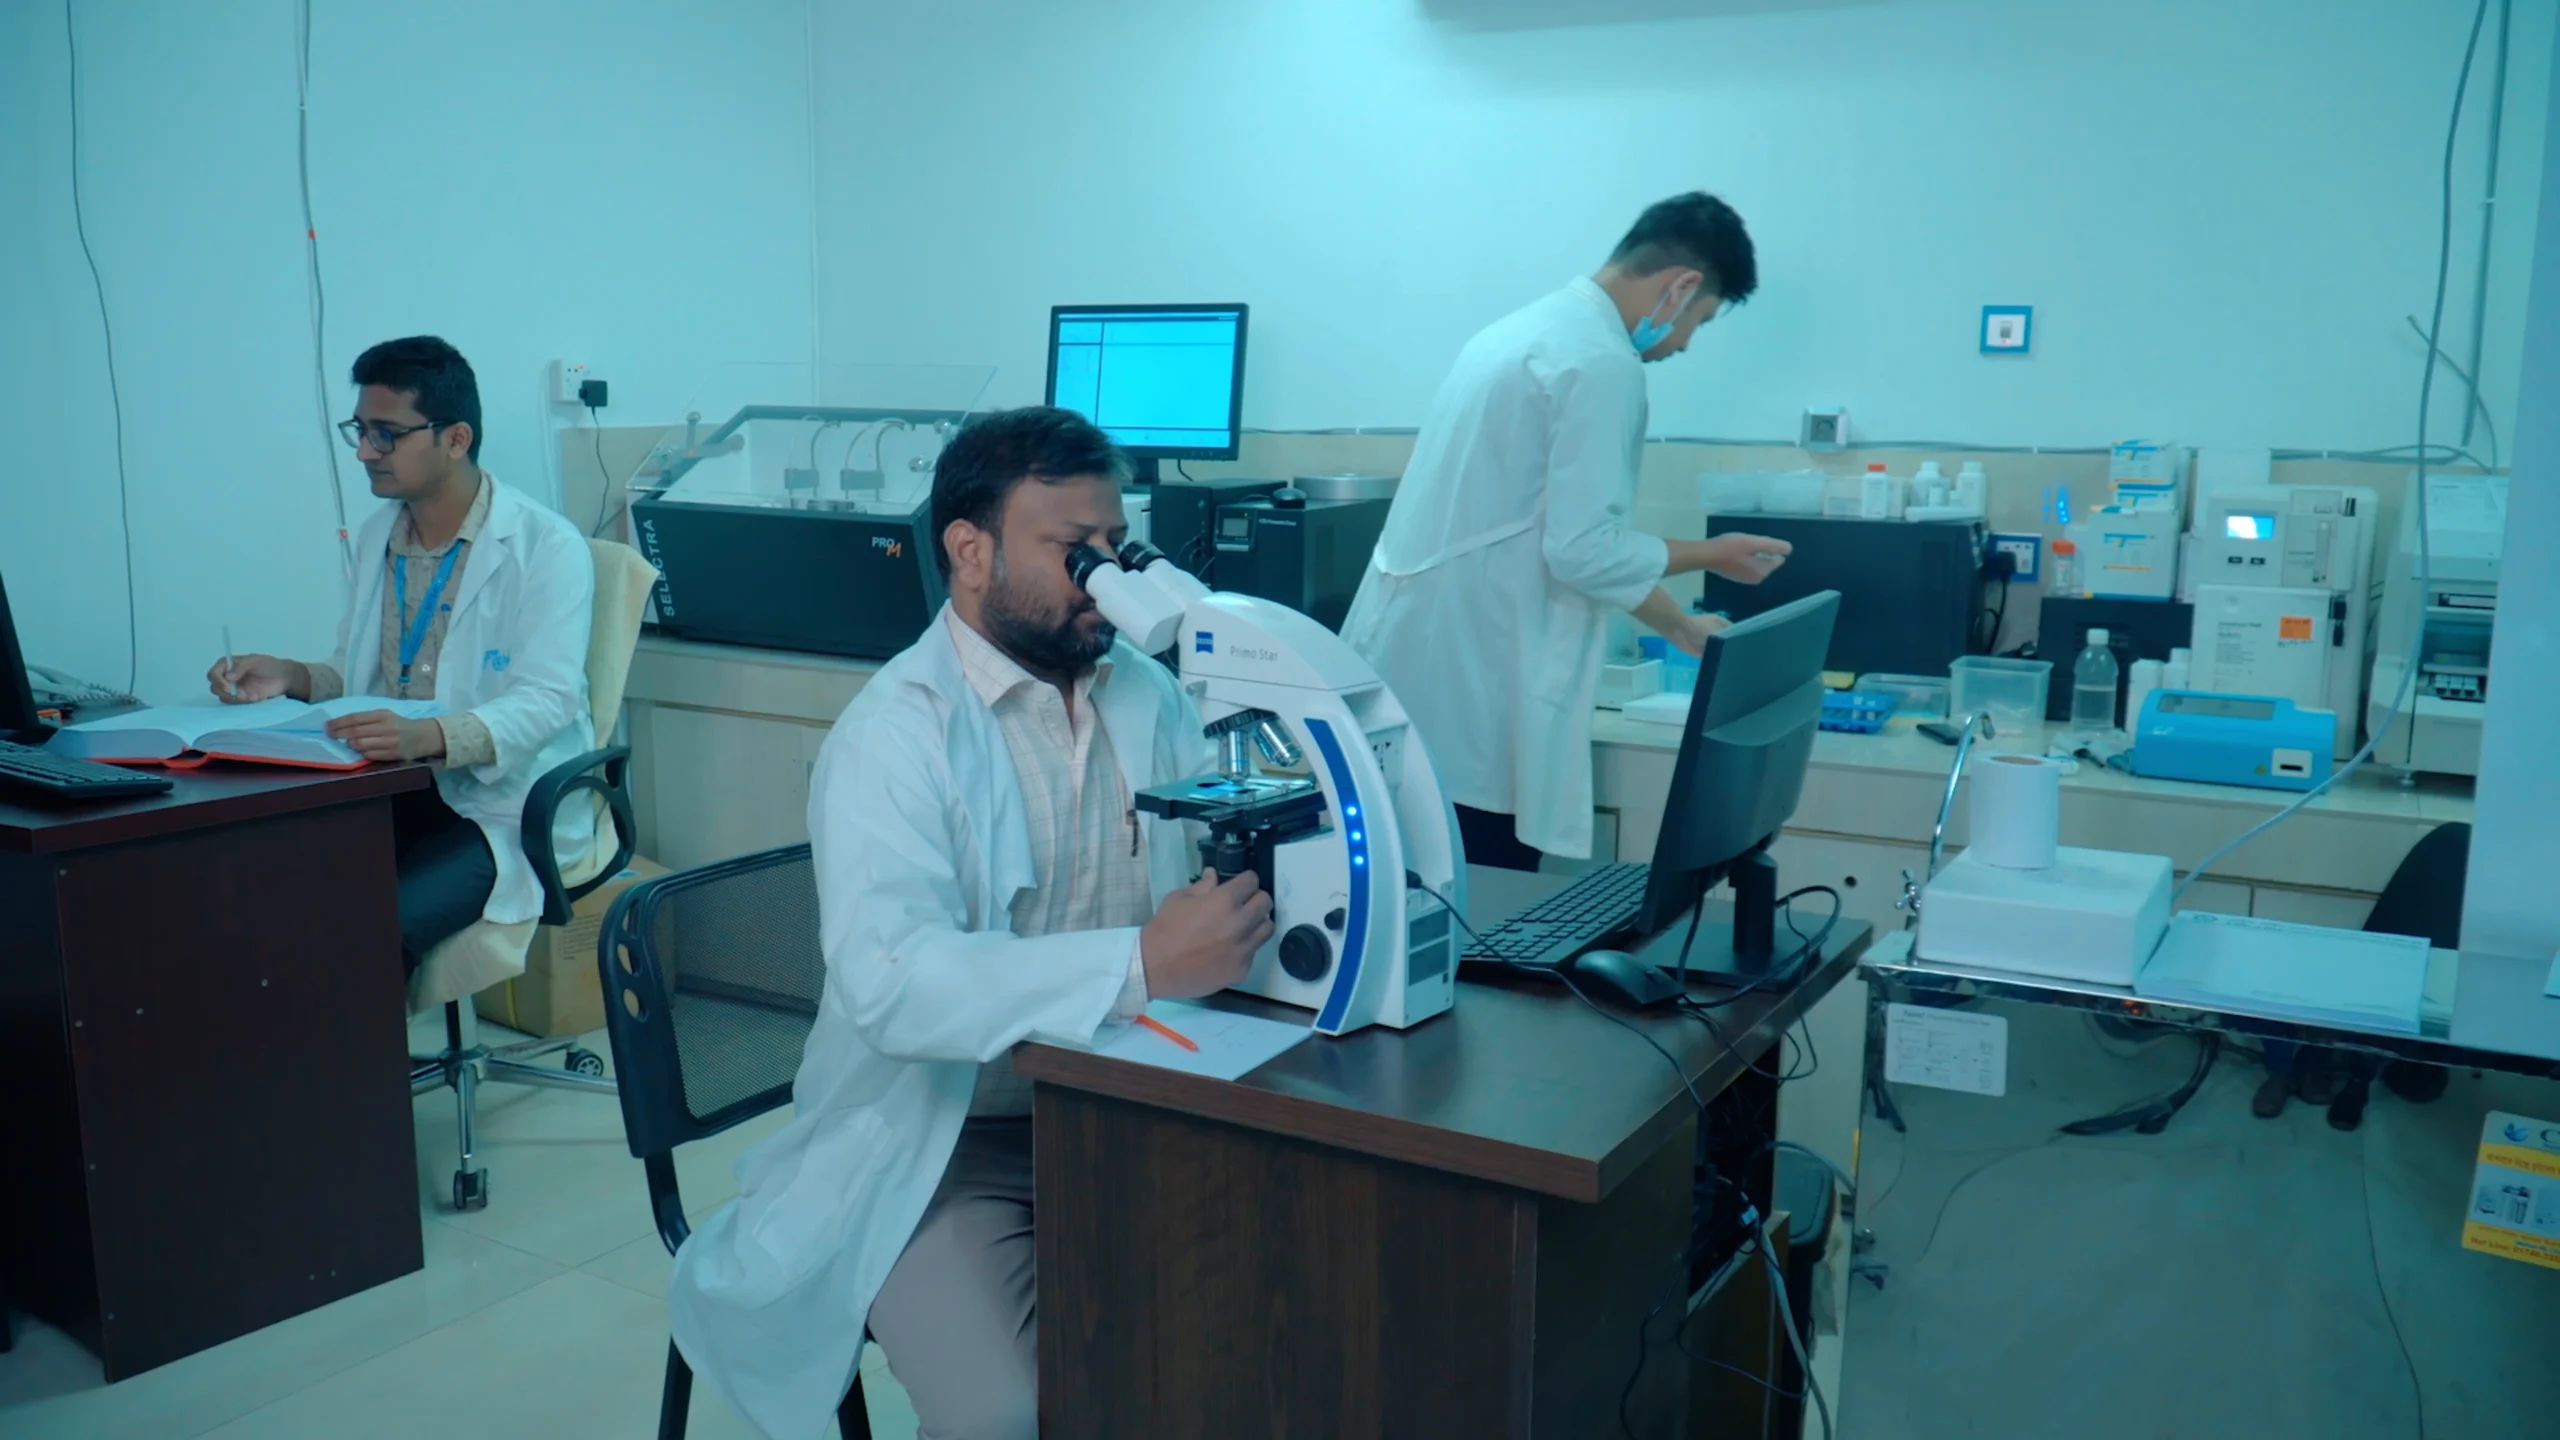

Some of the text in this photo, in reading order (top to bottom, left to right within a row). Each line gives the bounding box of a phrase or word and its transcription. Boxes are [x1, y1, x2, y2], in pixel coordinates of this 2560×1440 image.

[871, 536, 896, 548] PRO
[643, 519, 675, 617] SELECTRA
[1230, 645, 1278, 662] Primo Star
